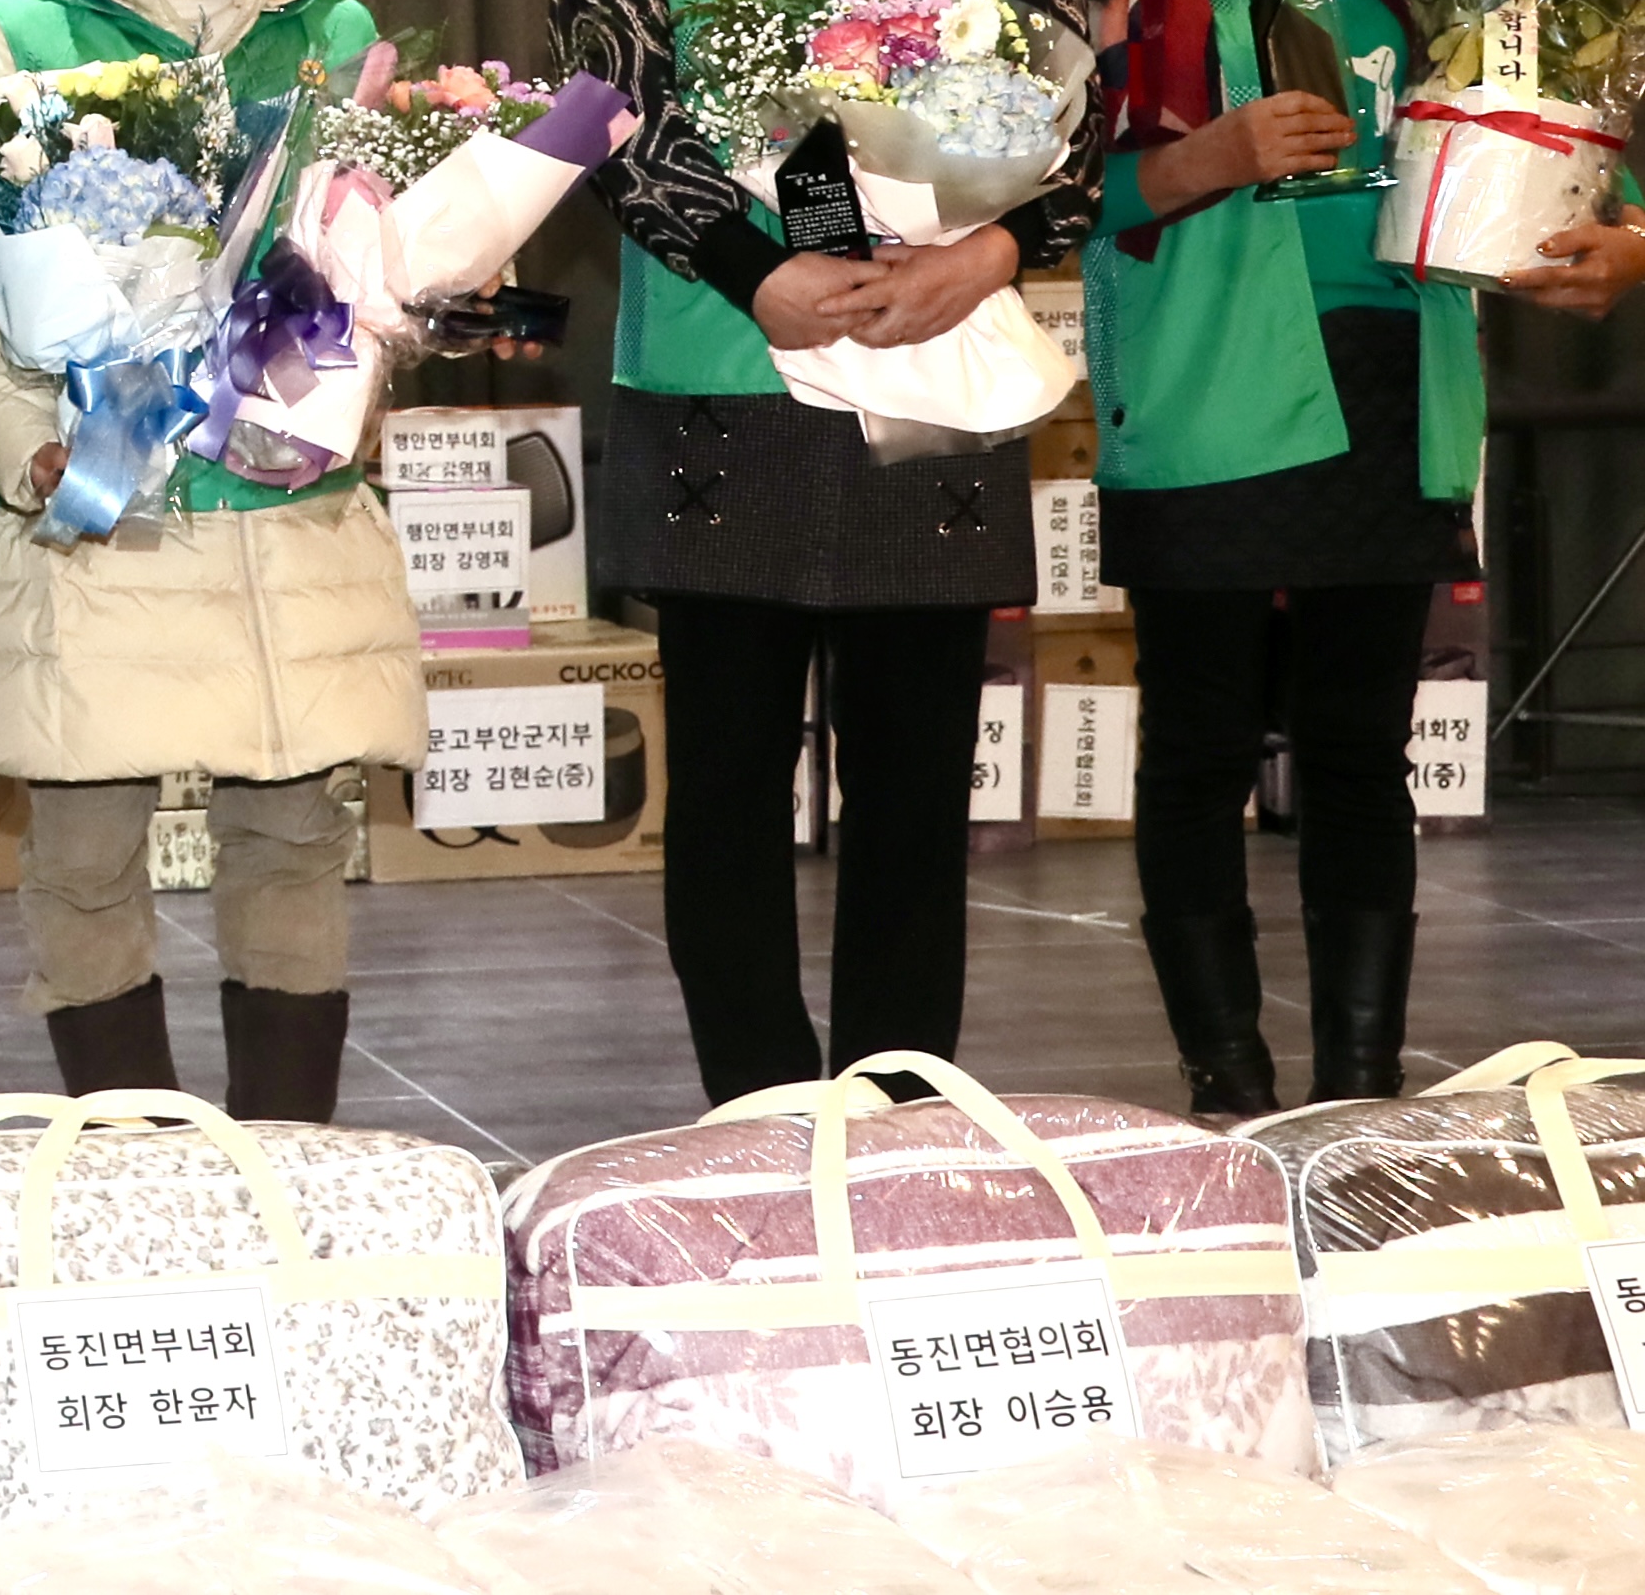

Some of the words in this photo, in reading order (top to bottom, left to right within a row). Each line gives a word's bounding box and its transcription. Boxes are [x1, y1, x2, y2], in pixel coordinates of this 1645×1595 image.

[406, 520, 514, 542] 행안면부녀회
[410, 552, 445, 572] 회장
[457, 551, 510, 571] 강영재
[424, 769, 471, 793] 회장
[40, 1322, 256, 1371] 동진면부녀회
[890, 1318, 1110, 1377] 동진면협의회
[57, 1392, 128, 1432] 회장
[149, 1383, 257, 1426] 한윤자
[910, 1397, 984, 1440] 회장
[1007, 1385, 1114, 1429] 이승용
